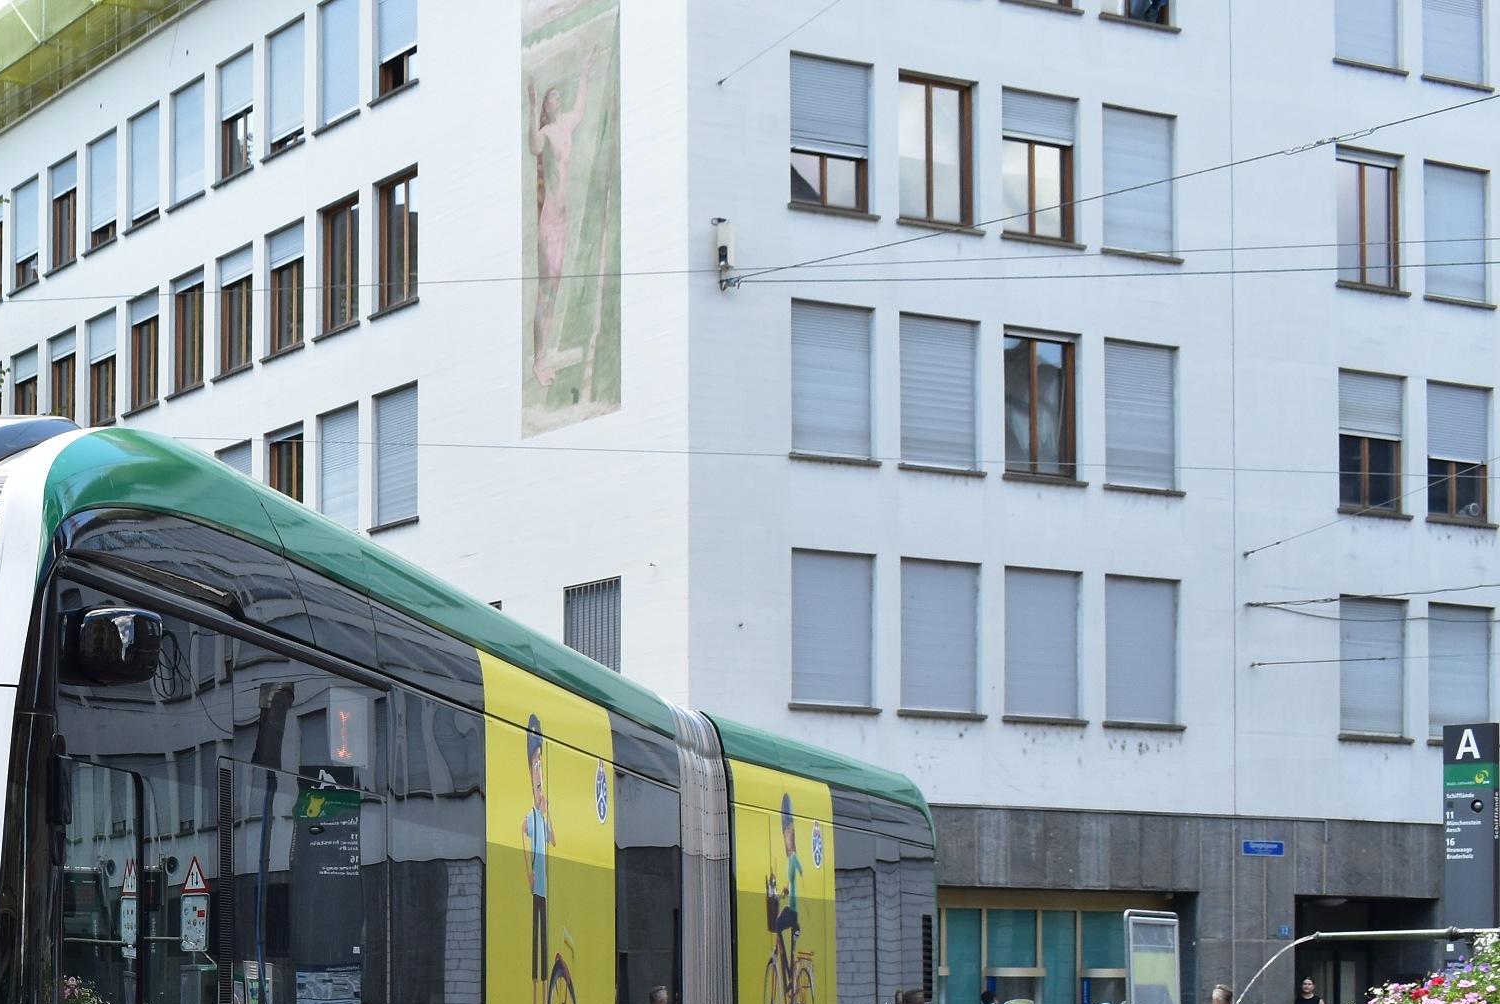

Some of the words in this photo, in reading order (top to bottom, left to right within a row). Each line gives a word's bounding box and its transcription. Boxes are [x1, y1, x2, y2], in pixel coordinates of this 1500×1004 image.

[1456, 729, 1480, 760] A
[1446, 811, 1454, 820] 11
[1446, 838, 1455, 846] 16
